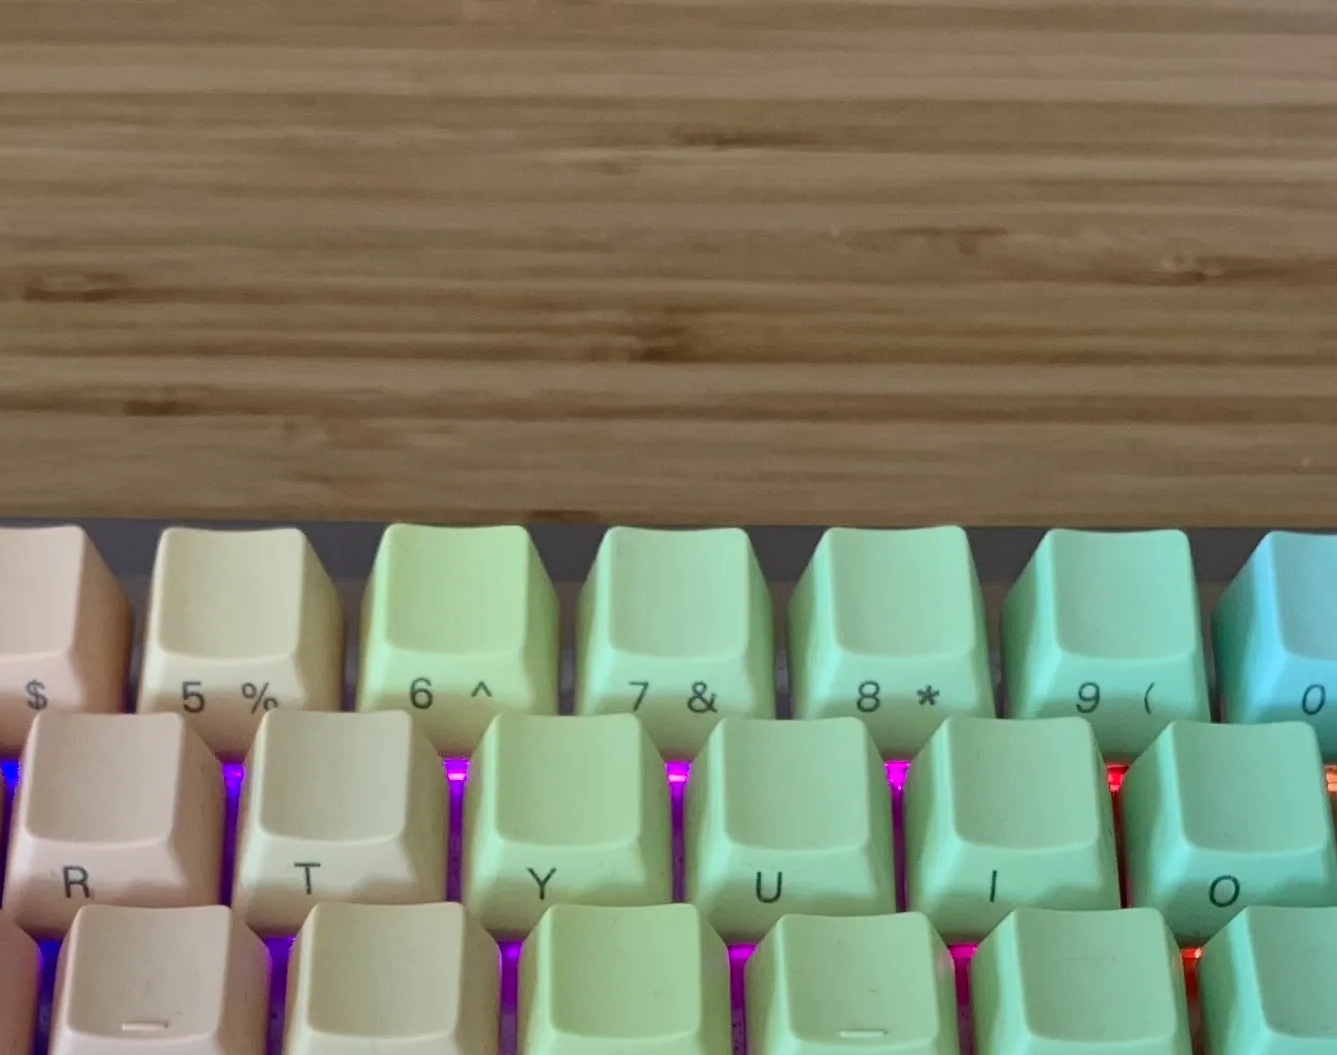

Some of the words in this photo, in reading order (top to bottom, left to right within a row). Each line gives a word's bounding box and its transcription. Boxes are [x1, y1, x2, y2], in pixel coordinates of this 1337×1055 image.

[25, 678, 48, 712] $
[181, 680, 206, 714] 5
[241, 681, 280, 715] %
[409, 676, 434, 710] 6
[628, 681, 650, 713] 7
[686, 680, 718, 714] &
[856, 680, 881, 713] 8
[1075, 681, 1101, 714] 9
[1143, 682, 1156, 715] (
[62, 865, 95, 900] R
[293, 861, 322, 895] T
[526, 867, 557, 901] Y
[755, 871, 783, 904] U
[1208, 874, 1241, 908] O
